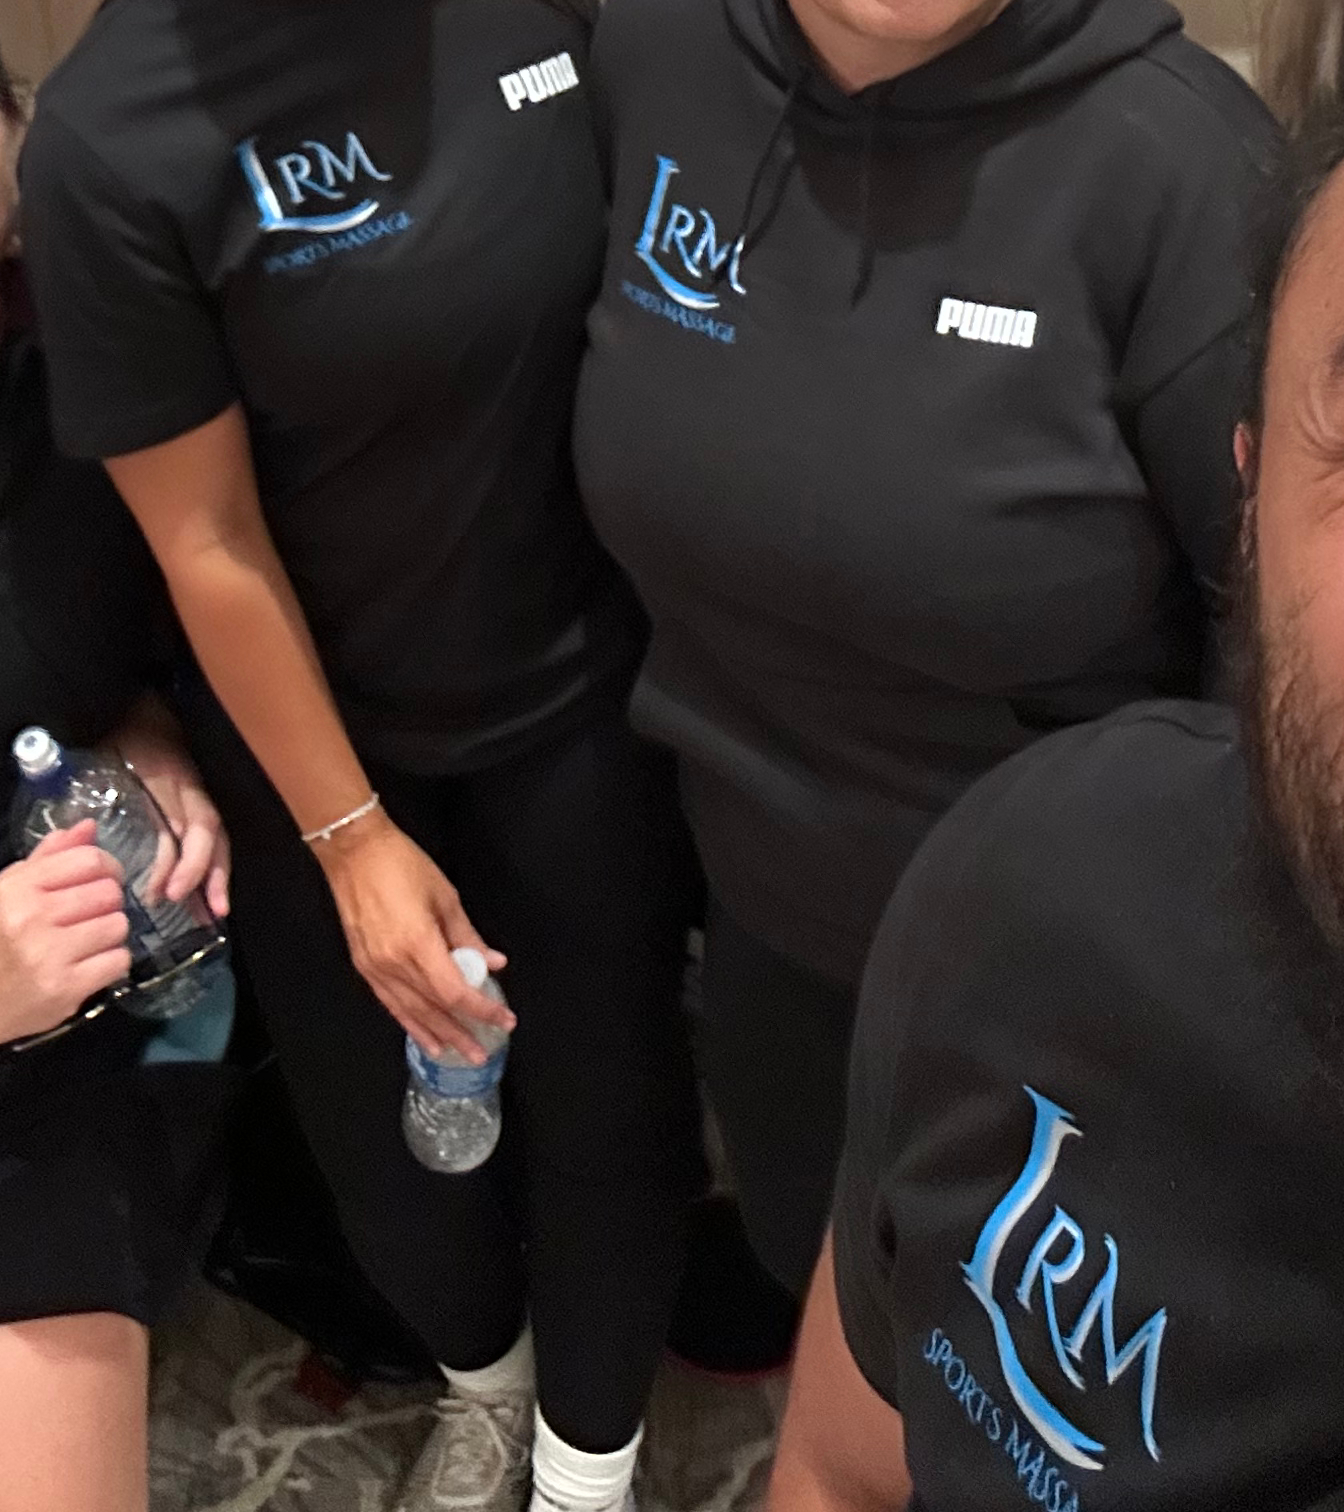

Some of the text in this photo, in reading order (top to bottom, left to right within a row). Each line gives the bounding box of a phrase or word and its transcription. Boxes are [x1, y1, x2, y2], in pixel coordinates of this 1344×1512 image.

[499, 51, 580, 112] PUMA
[935, 298, 1038, 348] PUMA
[924, 1328, 1002, 1440] SPORTS
